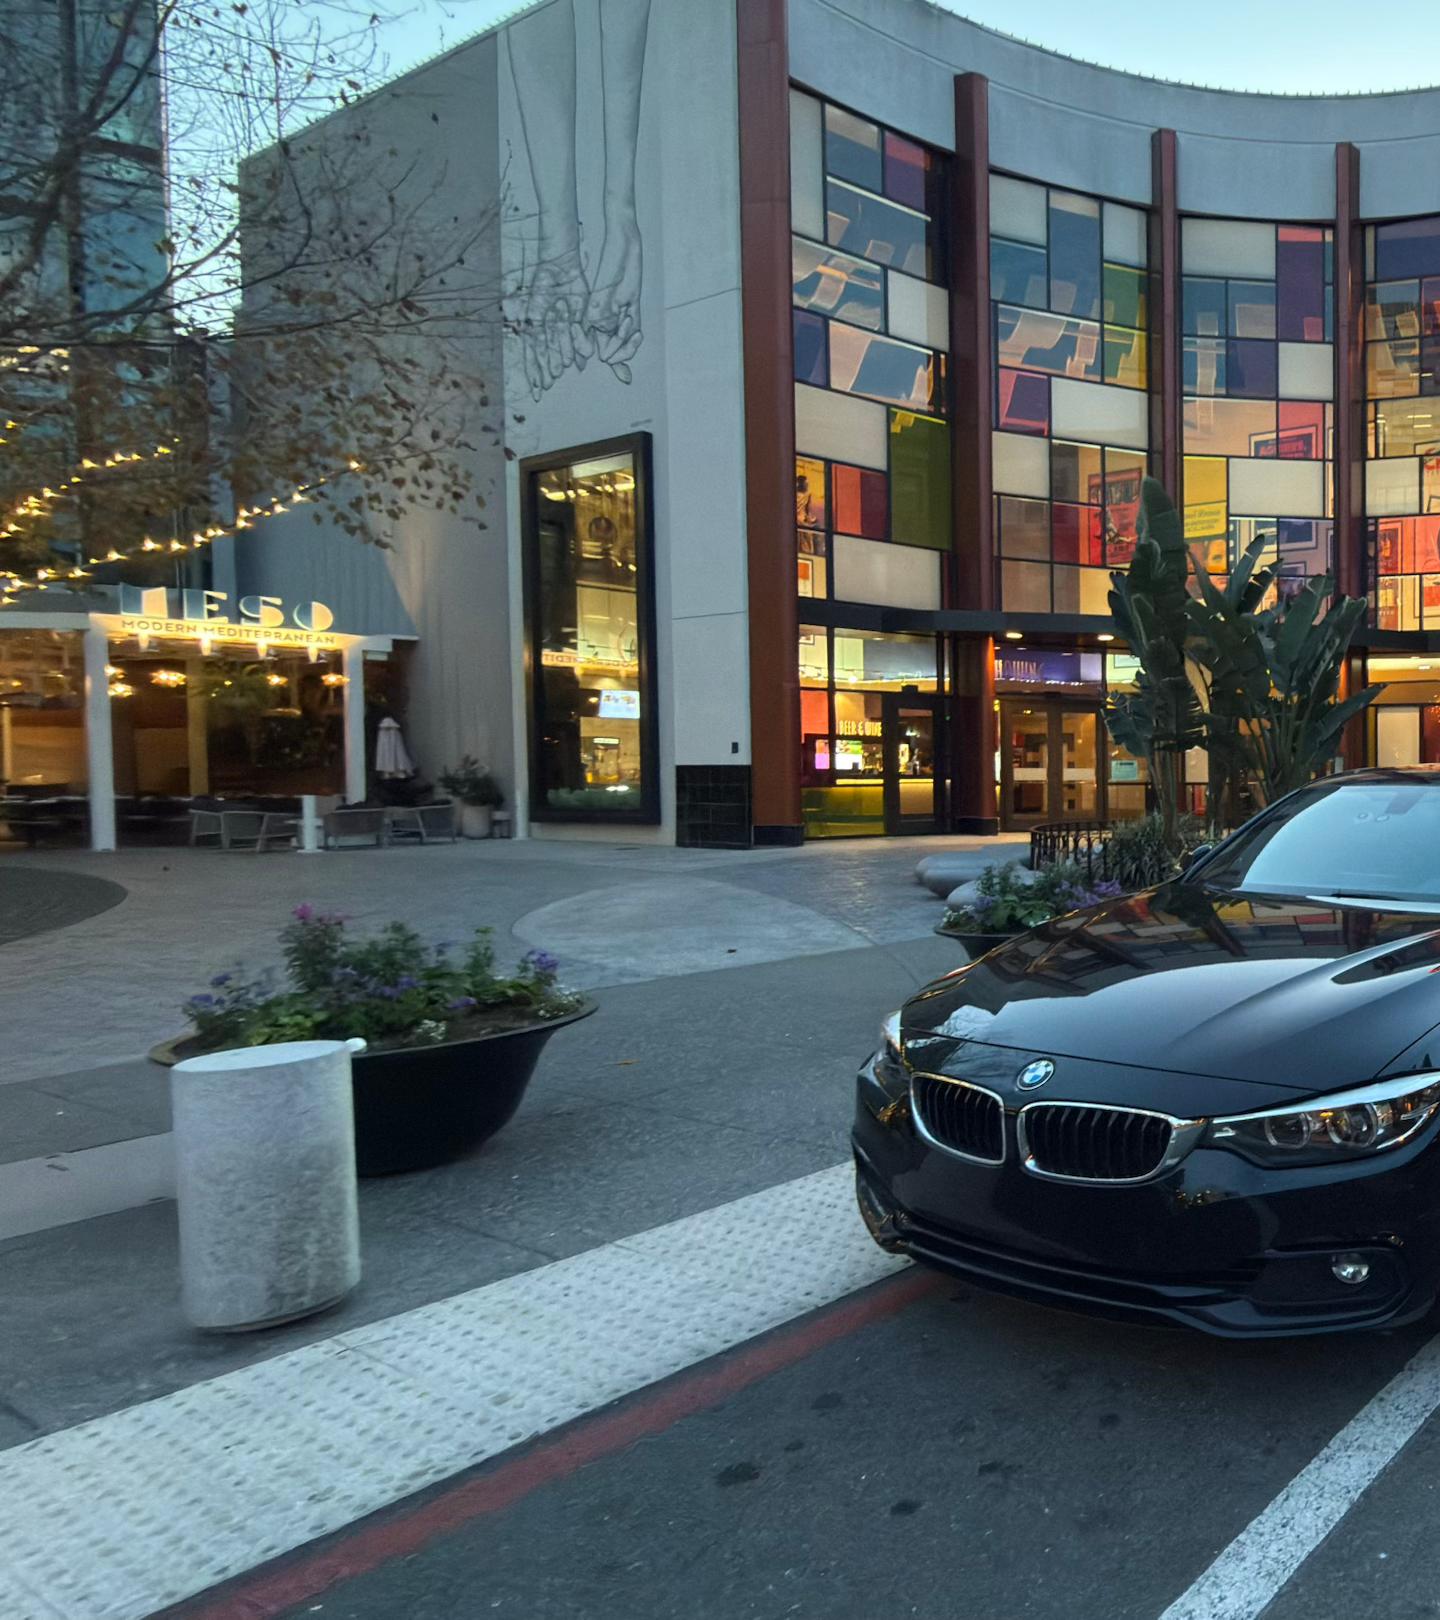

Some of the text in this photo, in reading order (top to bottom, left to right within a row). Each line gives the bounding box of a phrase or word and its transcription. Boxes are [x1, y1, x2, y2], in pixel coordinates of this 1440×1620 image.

[121, 619, 335, 645] MODERN MEDITERRANEAN
[839, 720, 857, 736] BEER
[865, 721, 882, 737] WINE
